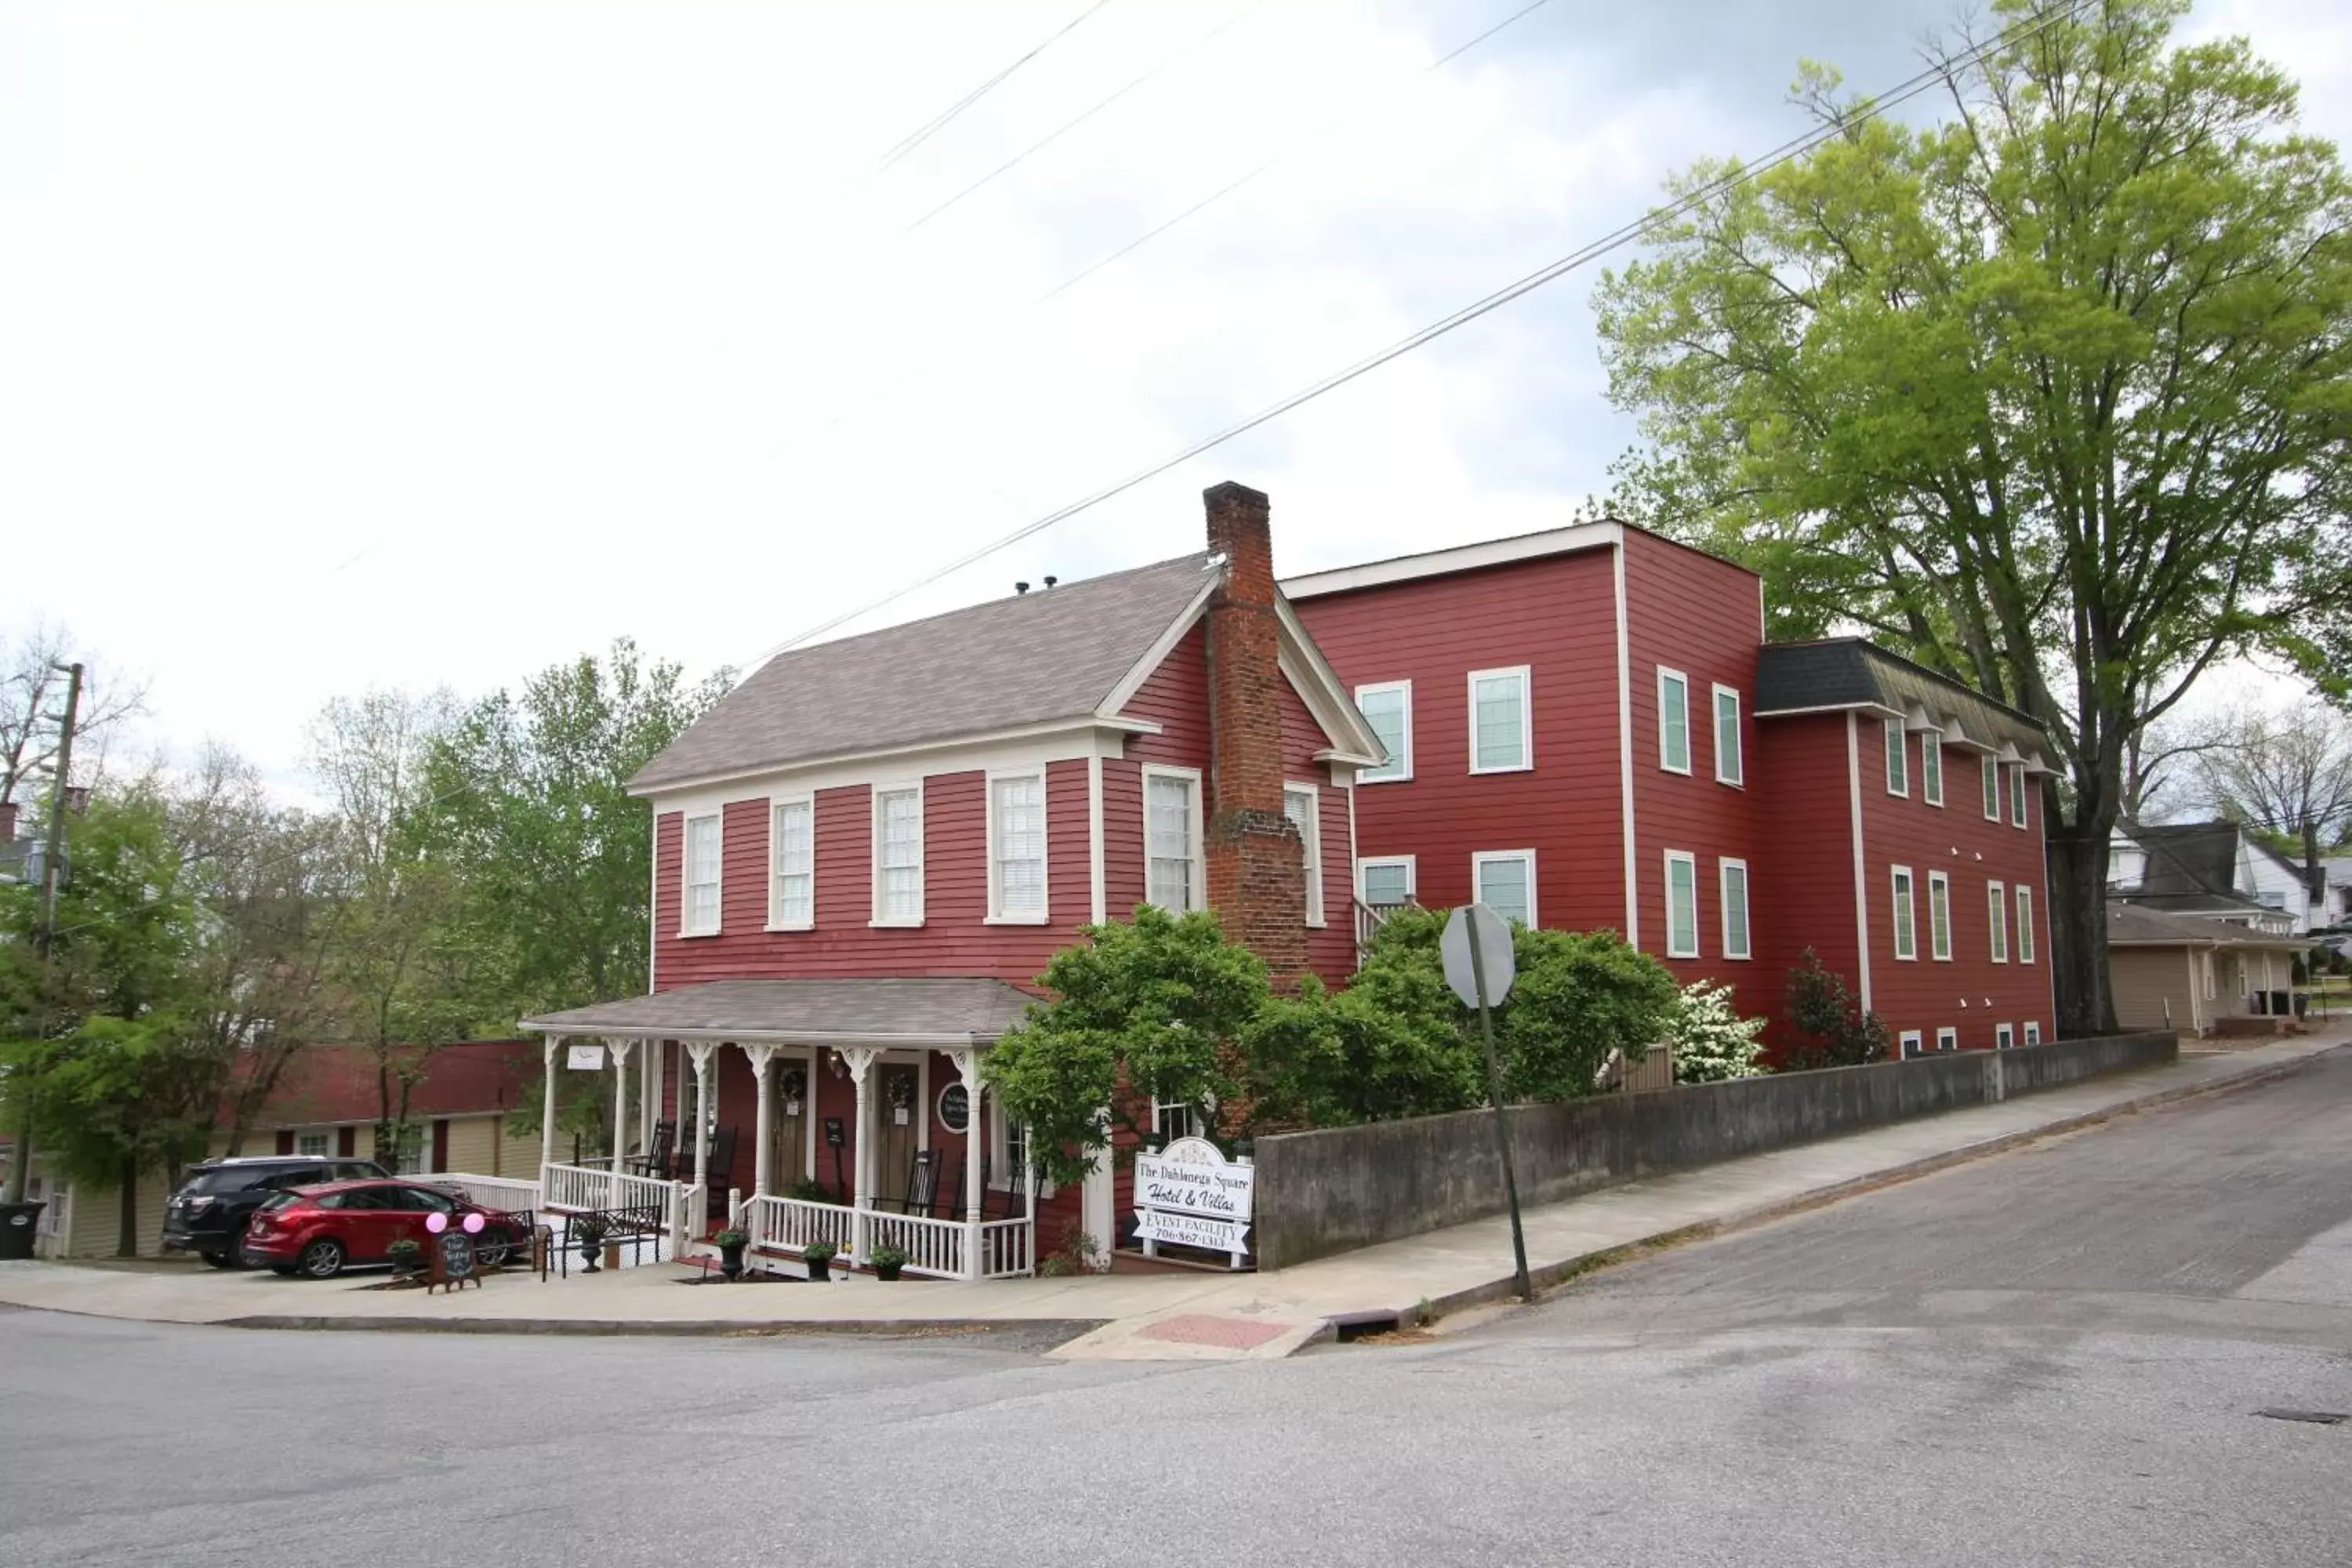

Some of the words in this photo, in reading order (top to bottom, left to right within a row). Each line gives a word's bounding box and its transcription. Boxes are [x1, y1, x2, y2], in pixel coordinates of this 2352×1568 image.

[1140, 1163, 1157, 1177] The
[1214, 1172, 1249, 1192] Square
[1147, 1183, 1182, 1203] Hotel
[1185, 1189, 1196, 1206] &
[1199, 1191, 1235, 1212] Villas
[1145, 1213, 1182, 1229] EVENT
[1185, 1219, 1238, 1240] FACILITY
